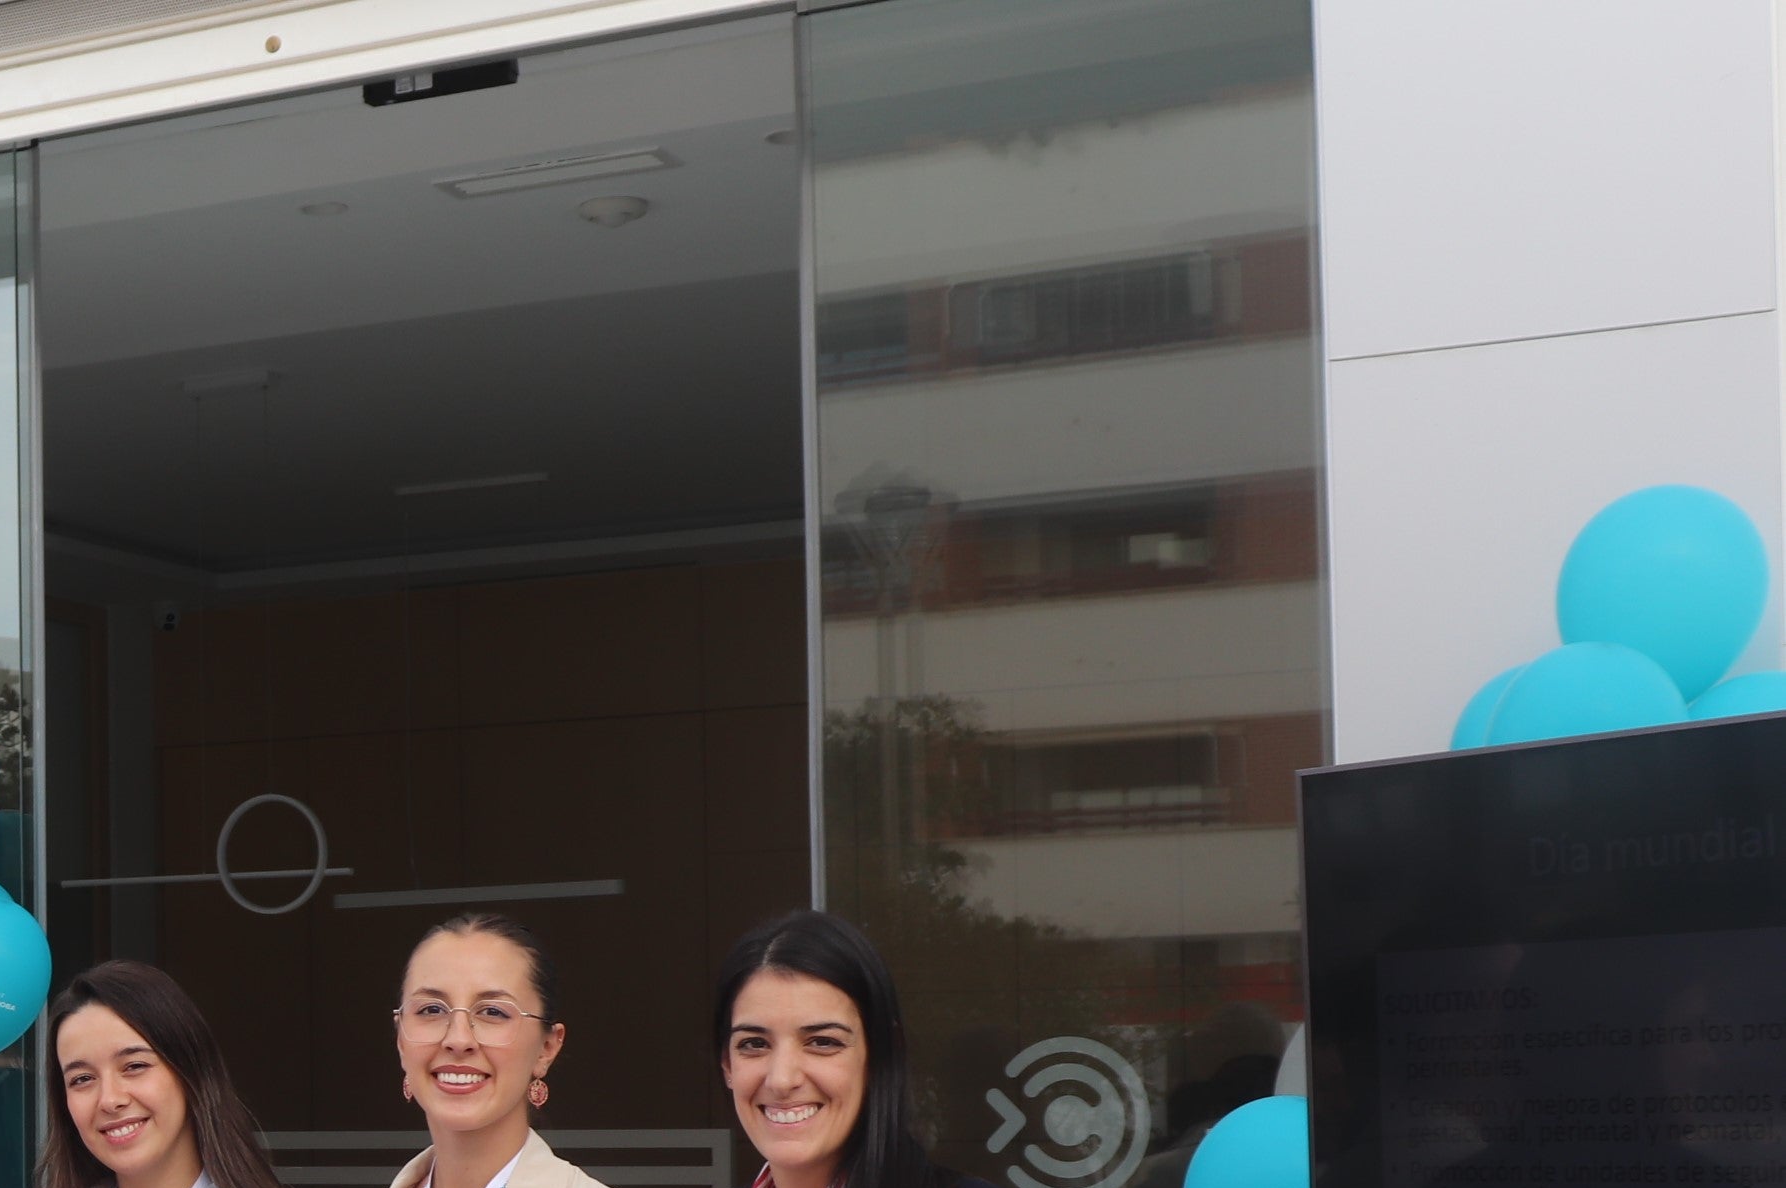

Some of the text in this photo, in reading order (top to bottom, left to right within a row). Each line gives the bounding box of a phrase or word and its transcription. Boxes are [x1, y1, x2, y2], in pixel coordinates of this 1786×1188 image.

[1529, 812, 1776, 877] Día mundial
[1523, 1022, 1633, 1055] específica
[1640, 1021, 1694, 1050] para
[1700, 1018, 1734, 1043] los
[1742, 1022, 1786, 1048] pro
[1608, 1093, 1637, 1116] de
[1644, 1089, 1773, 1119] protocolos
[1529, 1160, 1556, 1183] de
[1565, 1160, 1667, 1183] unidades
[1675, 1160, 1705, 1183] de
